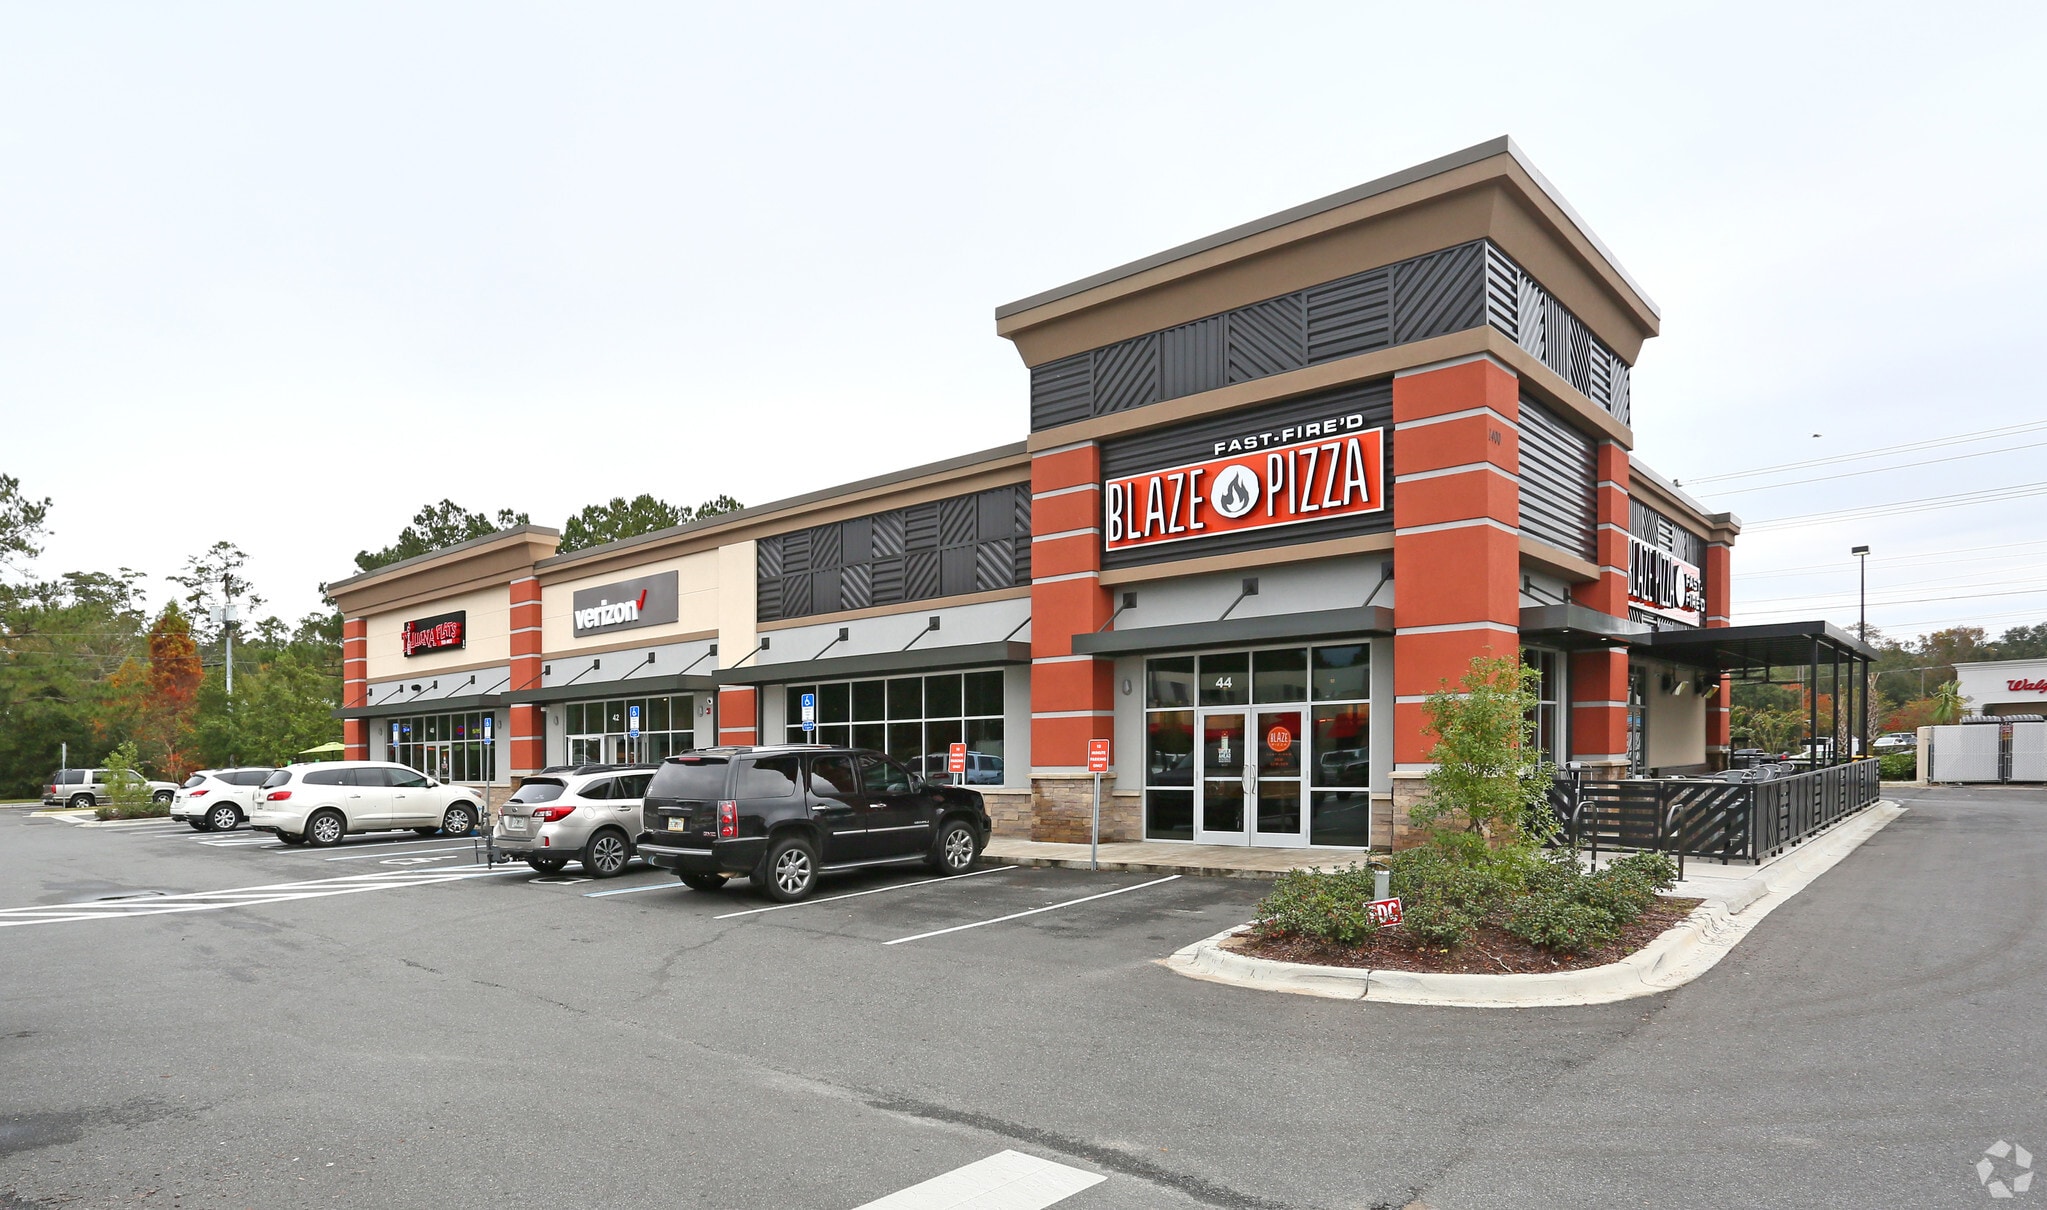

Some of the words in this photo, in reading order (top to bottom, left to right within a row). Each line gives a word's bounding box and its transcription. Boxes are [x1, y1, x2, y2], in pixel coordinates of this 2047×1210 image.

[1214, 413, 1364, 456] FAST-FIRE'D
[1108, 468, 1205, 542] BLAZE
[1267, 437, 1369, 518] PIZZA
[574, 599, 639, 630] verizon
[435, 621, 458, 640] FLATS
[1215, 677, 1232, 688] 44
[1270, 732, 1289, 743] BLAZE
